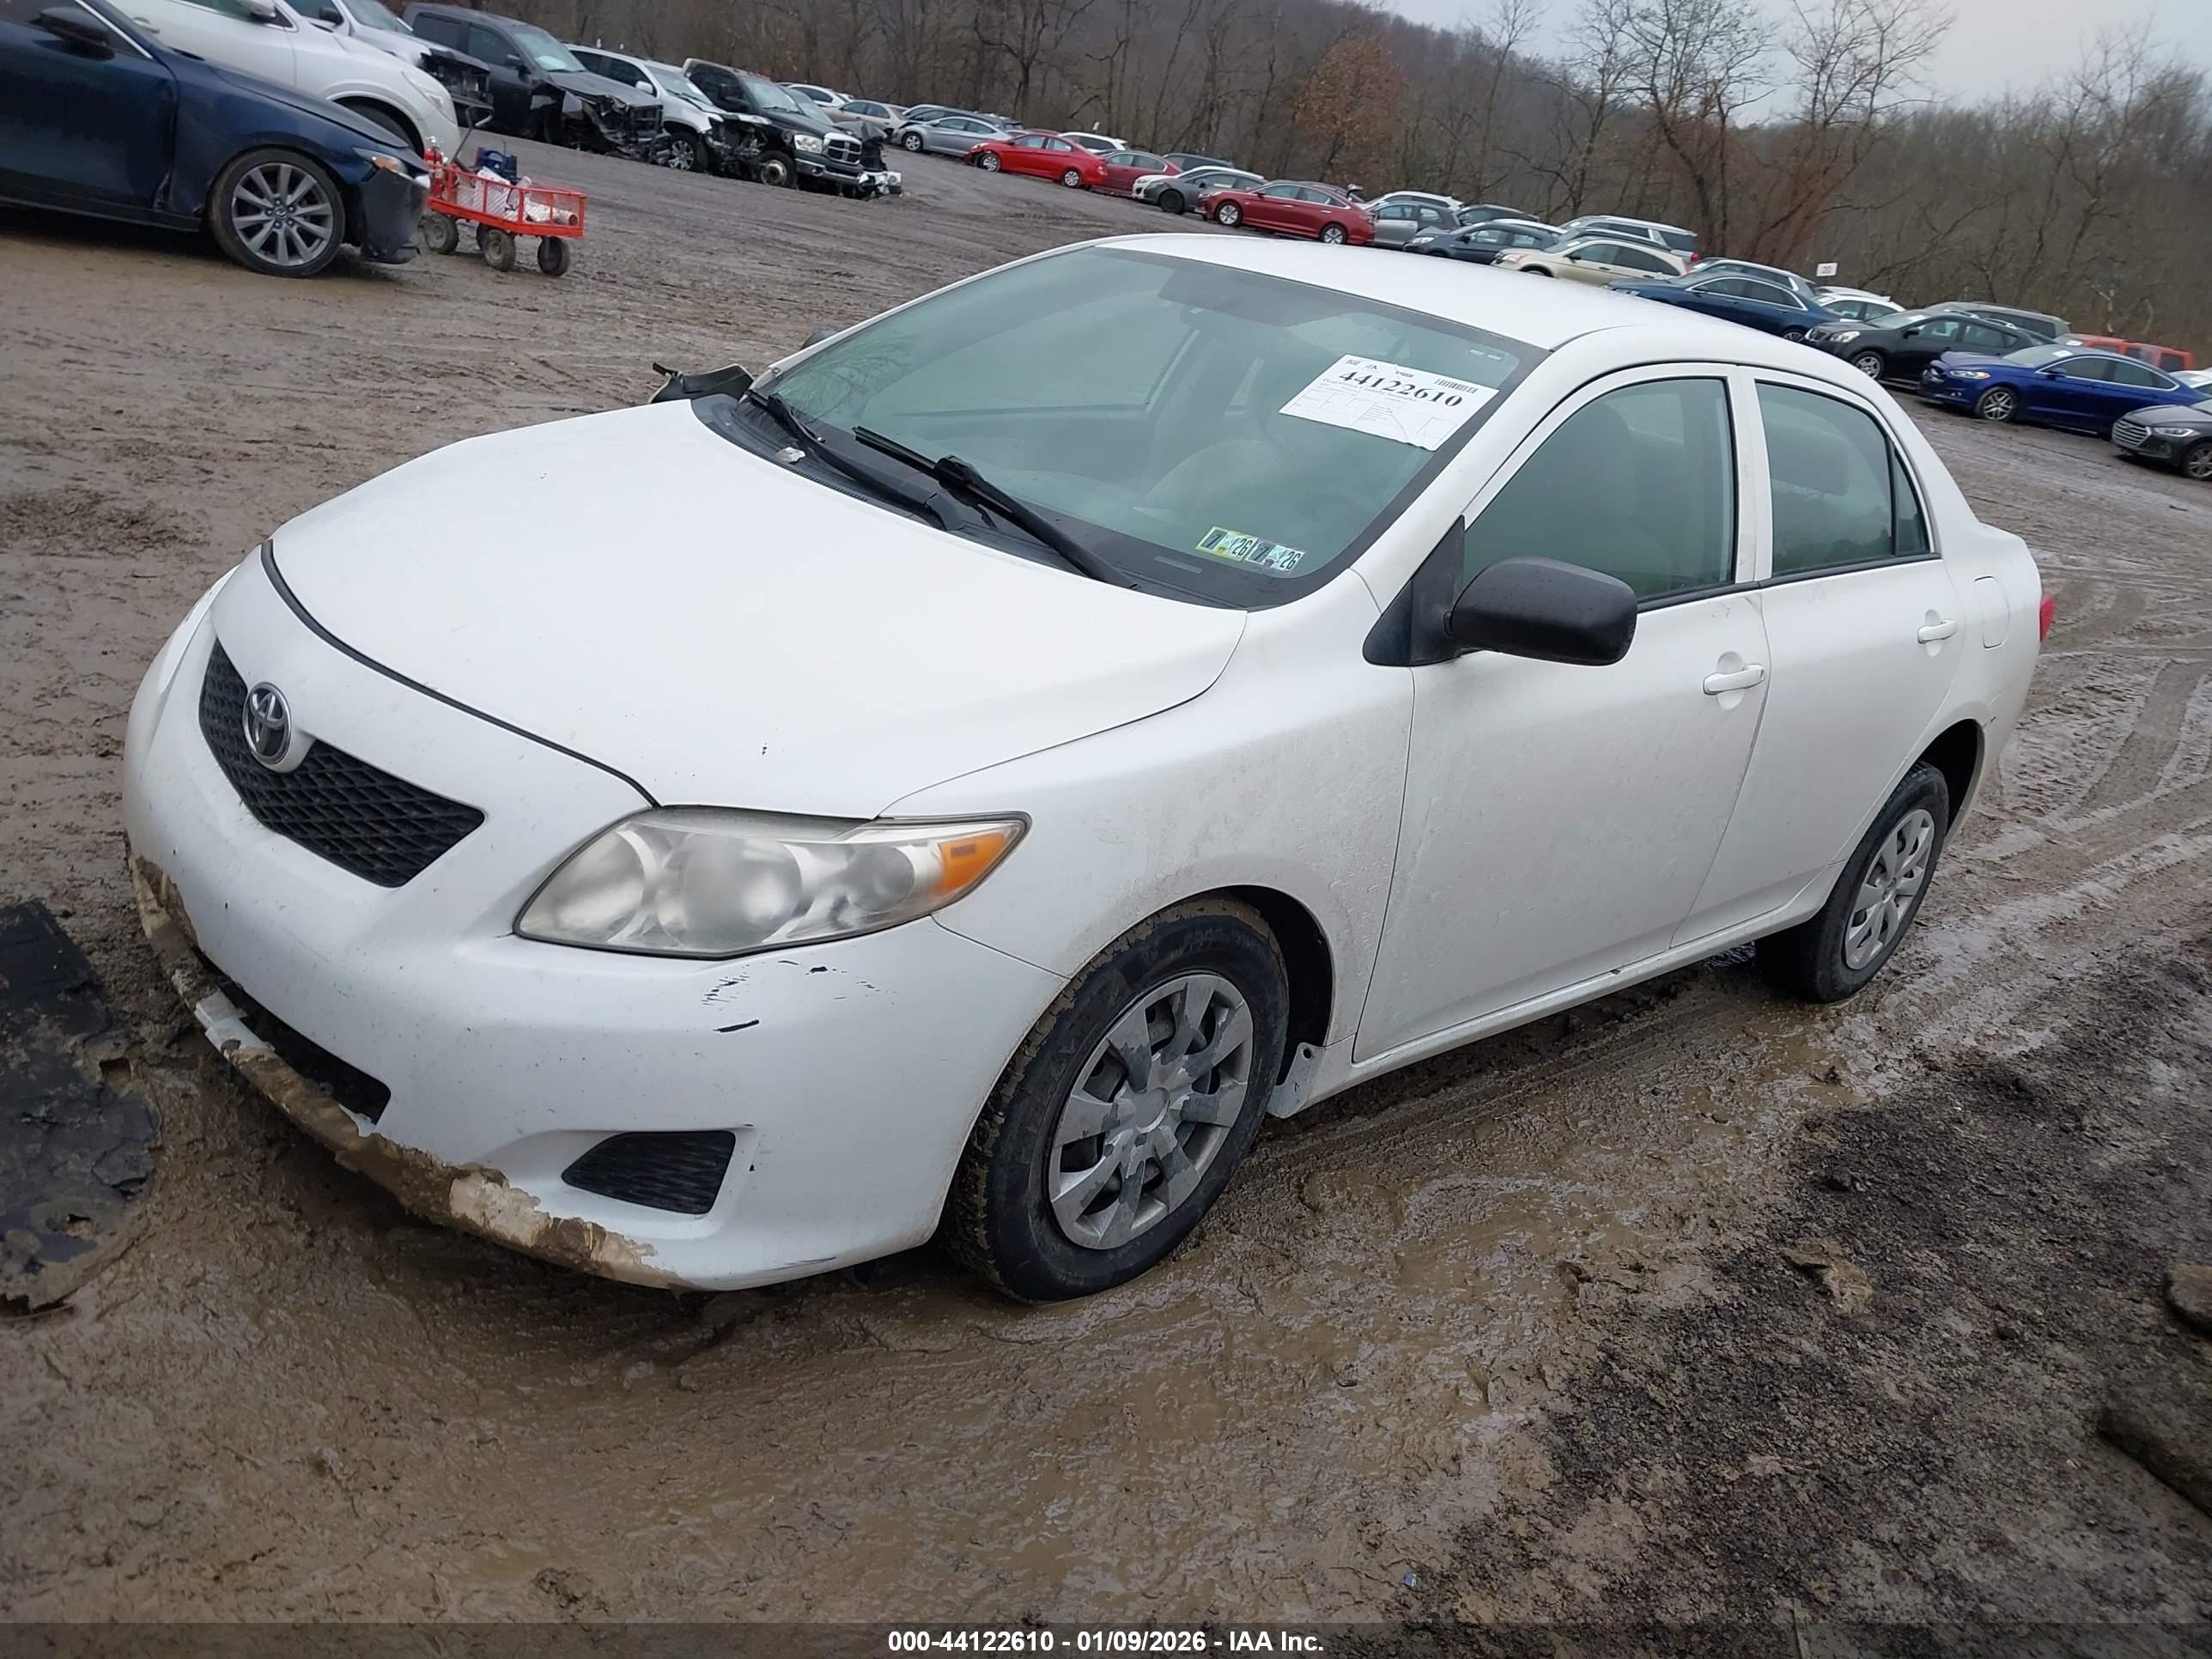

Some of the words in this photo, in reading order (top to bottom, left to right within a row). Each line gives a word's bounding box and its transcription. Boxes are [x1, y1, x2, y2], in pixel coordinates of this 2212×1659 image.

[1339, 371, 1463, 407] 44122610
[1231, 538, 1254, 556] 26
[1279, 550, 1302, 570] 26
